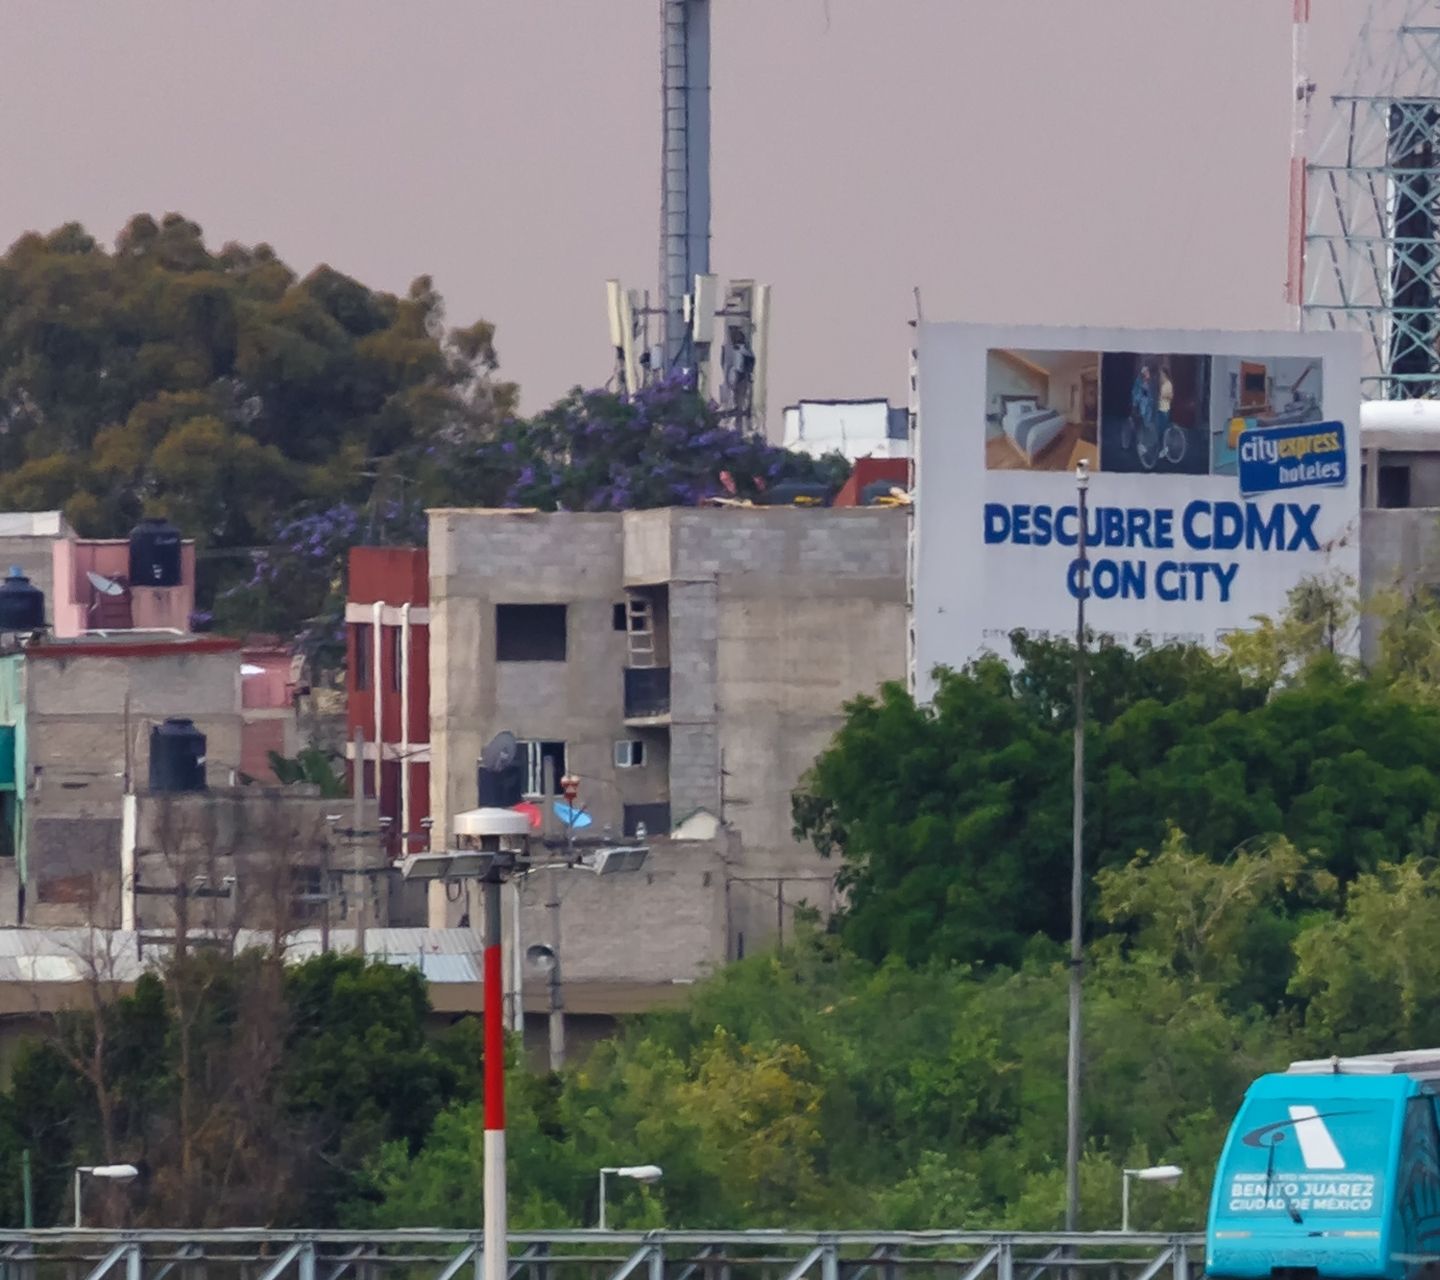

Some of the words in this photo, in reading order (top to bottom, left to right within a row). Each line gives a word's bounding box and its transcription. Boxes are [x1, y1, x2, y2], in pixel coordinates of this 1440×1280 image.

[1279, 461, 1341, 485] hoteles
[984, 502, 1174, 548] DESCUBRE
[1182, 499, 1321, 551] CDMX
[1066, 557, 1147, 599] CON
[1231, 1183, 1299, 1197] BENITO
[1229, 1199, 1286, 1212] CIUDAD
